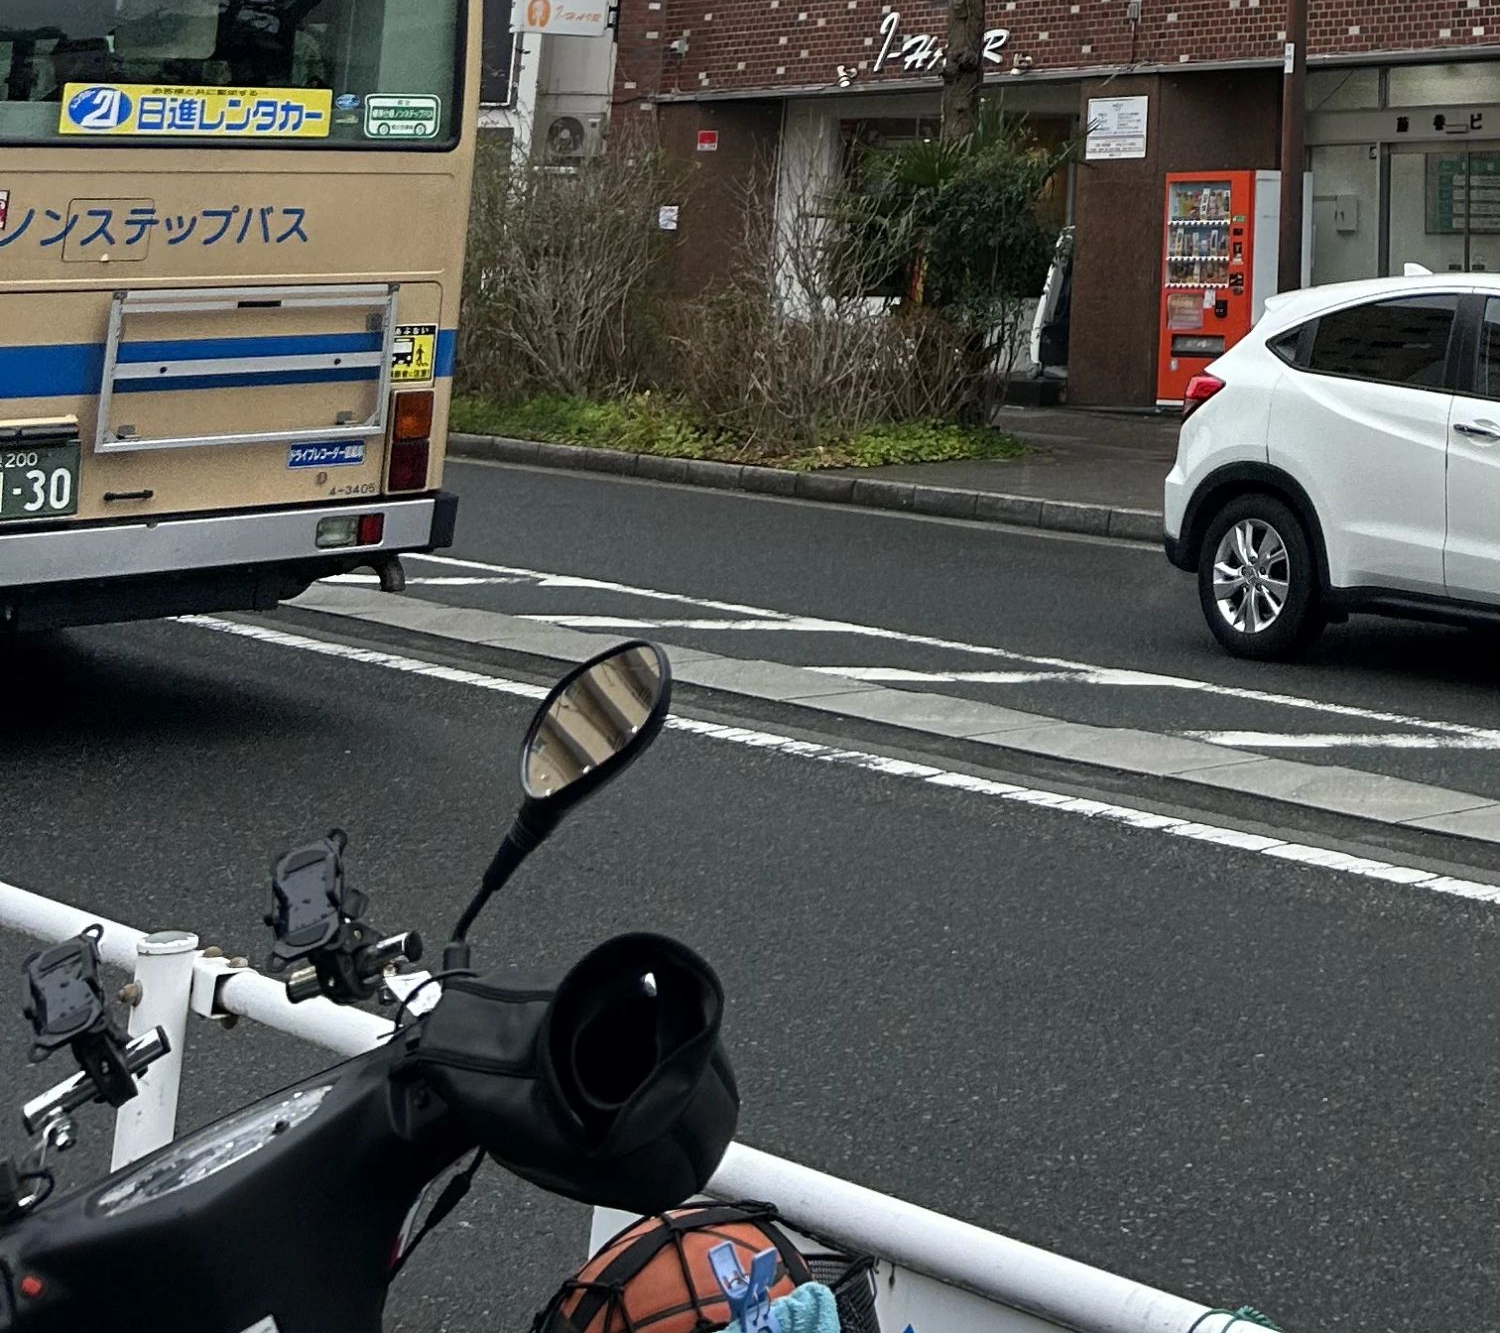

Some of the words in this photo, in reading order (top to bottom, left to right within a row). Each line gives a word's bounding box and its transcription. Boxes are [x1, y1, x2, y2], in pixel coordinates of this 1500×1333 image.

[873, 12, 1010, 72] I-HAR
[138, 96, 323, 132] 日進レンタカー
[0, 205, 308, 246] ノンステップバス
